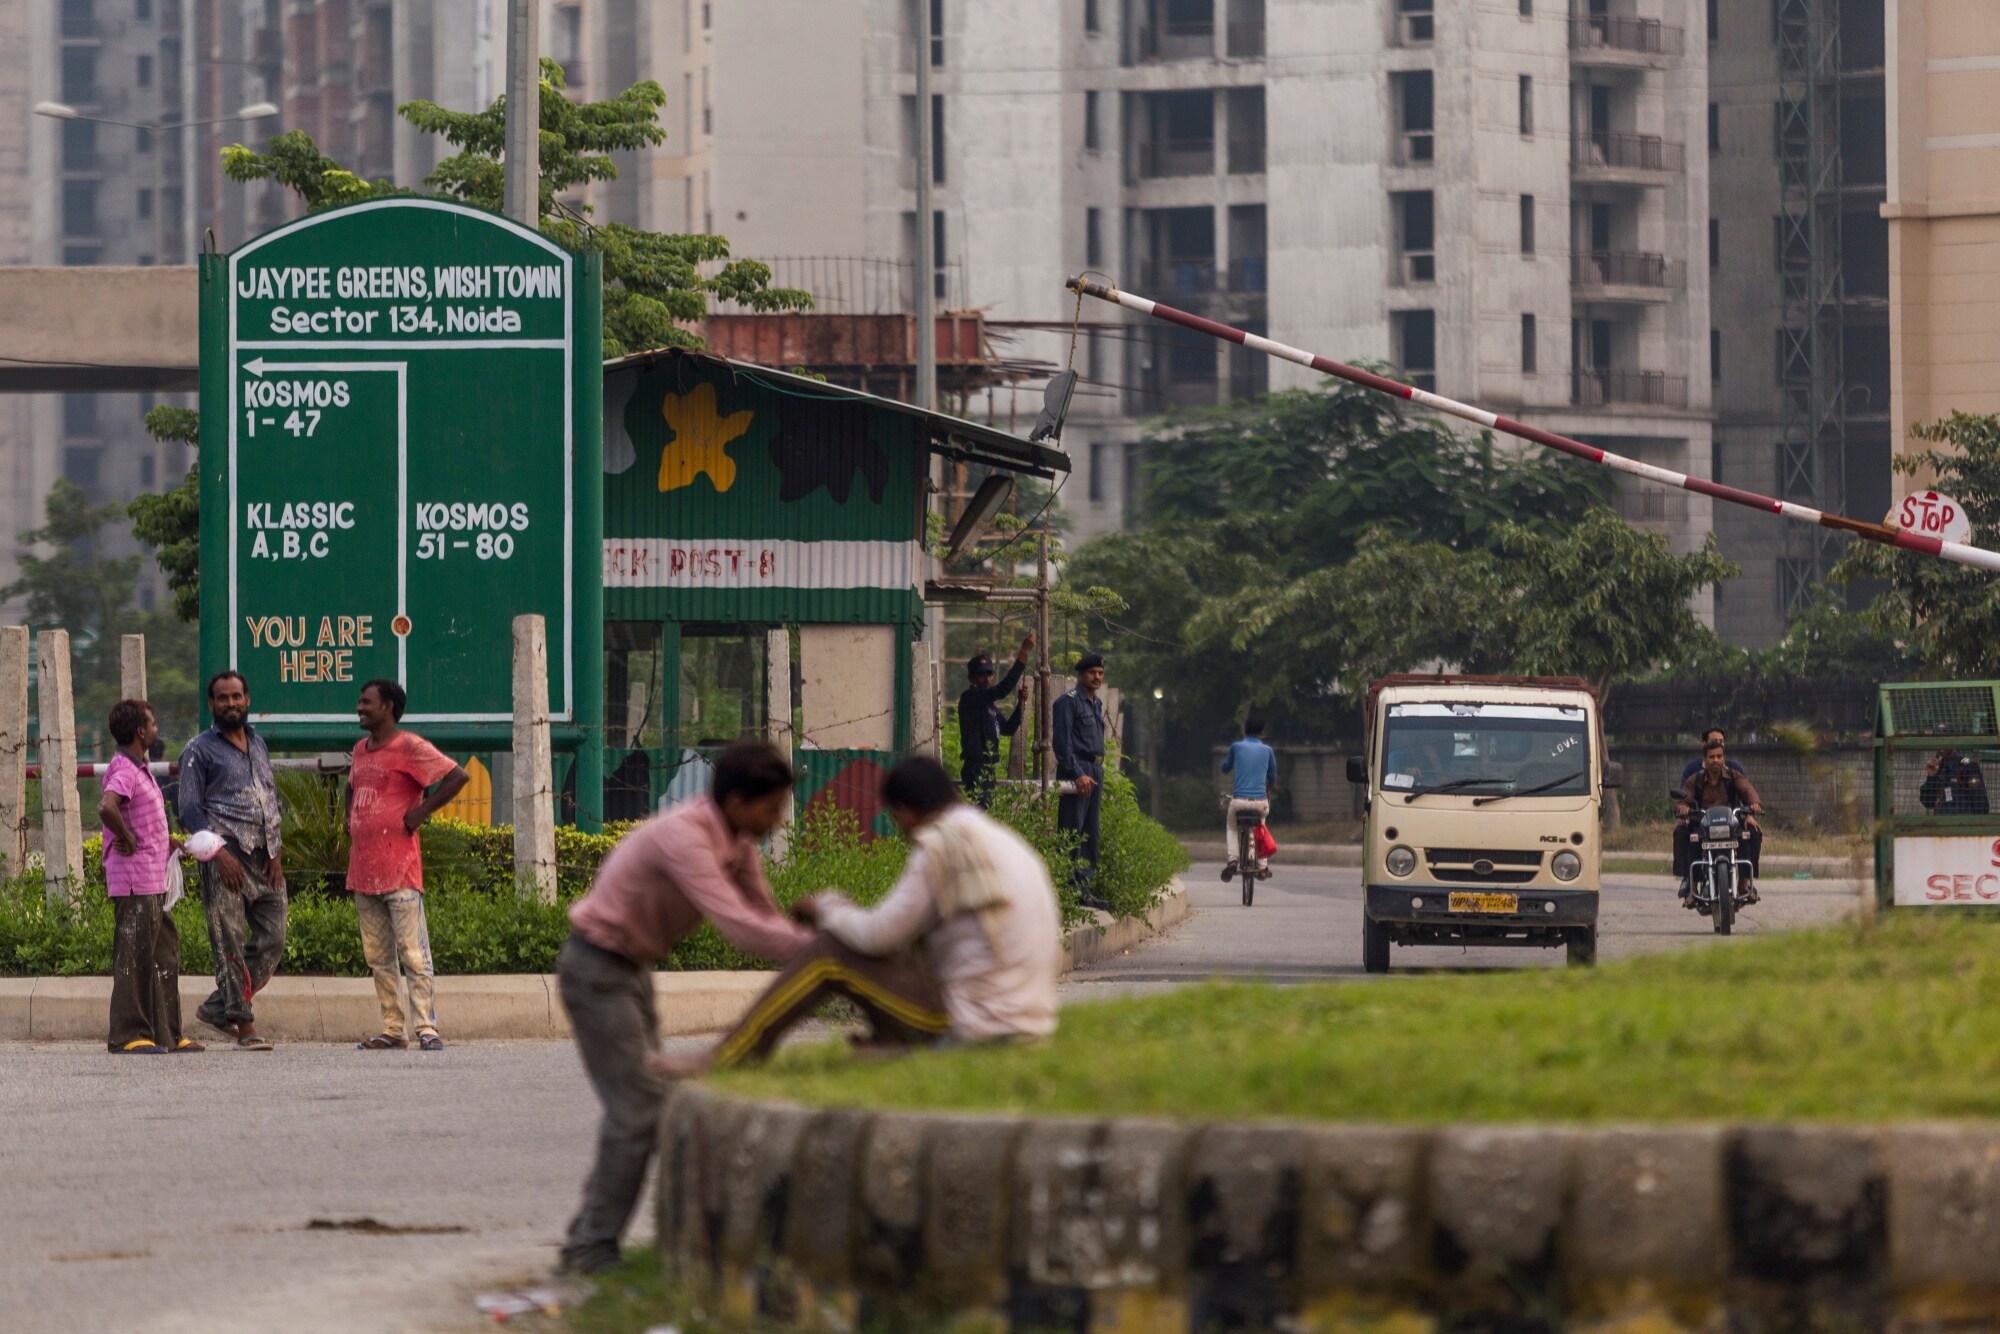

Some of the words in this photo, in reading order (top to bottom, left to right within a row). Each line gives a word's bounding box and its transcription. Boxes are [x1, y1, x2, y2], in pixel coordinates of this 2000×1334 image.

[238, 266, 331, 299] JAYPEE
[270, 306, 378, 333] Sector
[389, 306, 443, 334] 134,
[447, 306, 521, 332] Noida
[244, 381, 350, 407] KOSMOS
[248, 502, 355, 529] KLASSIC
[417, 503, 529, 531] KOSMOS
[1900, 496, 1955, 533] STOP
[246, 616, 305, 647] YOU
[317, 616, 373, 646] ARE
[280, 650, 353, 682] HERE
[1550, 736, 1578, 757] LOVE
